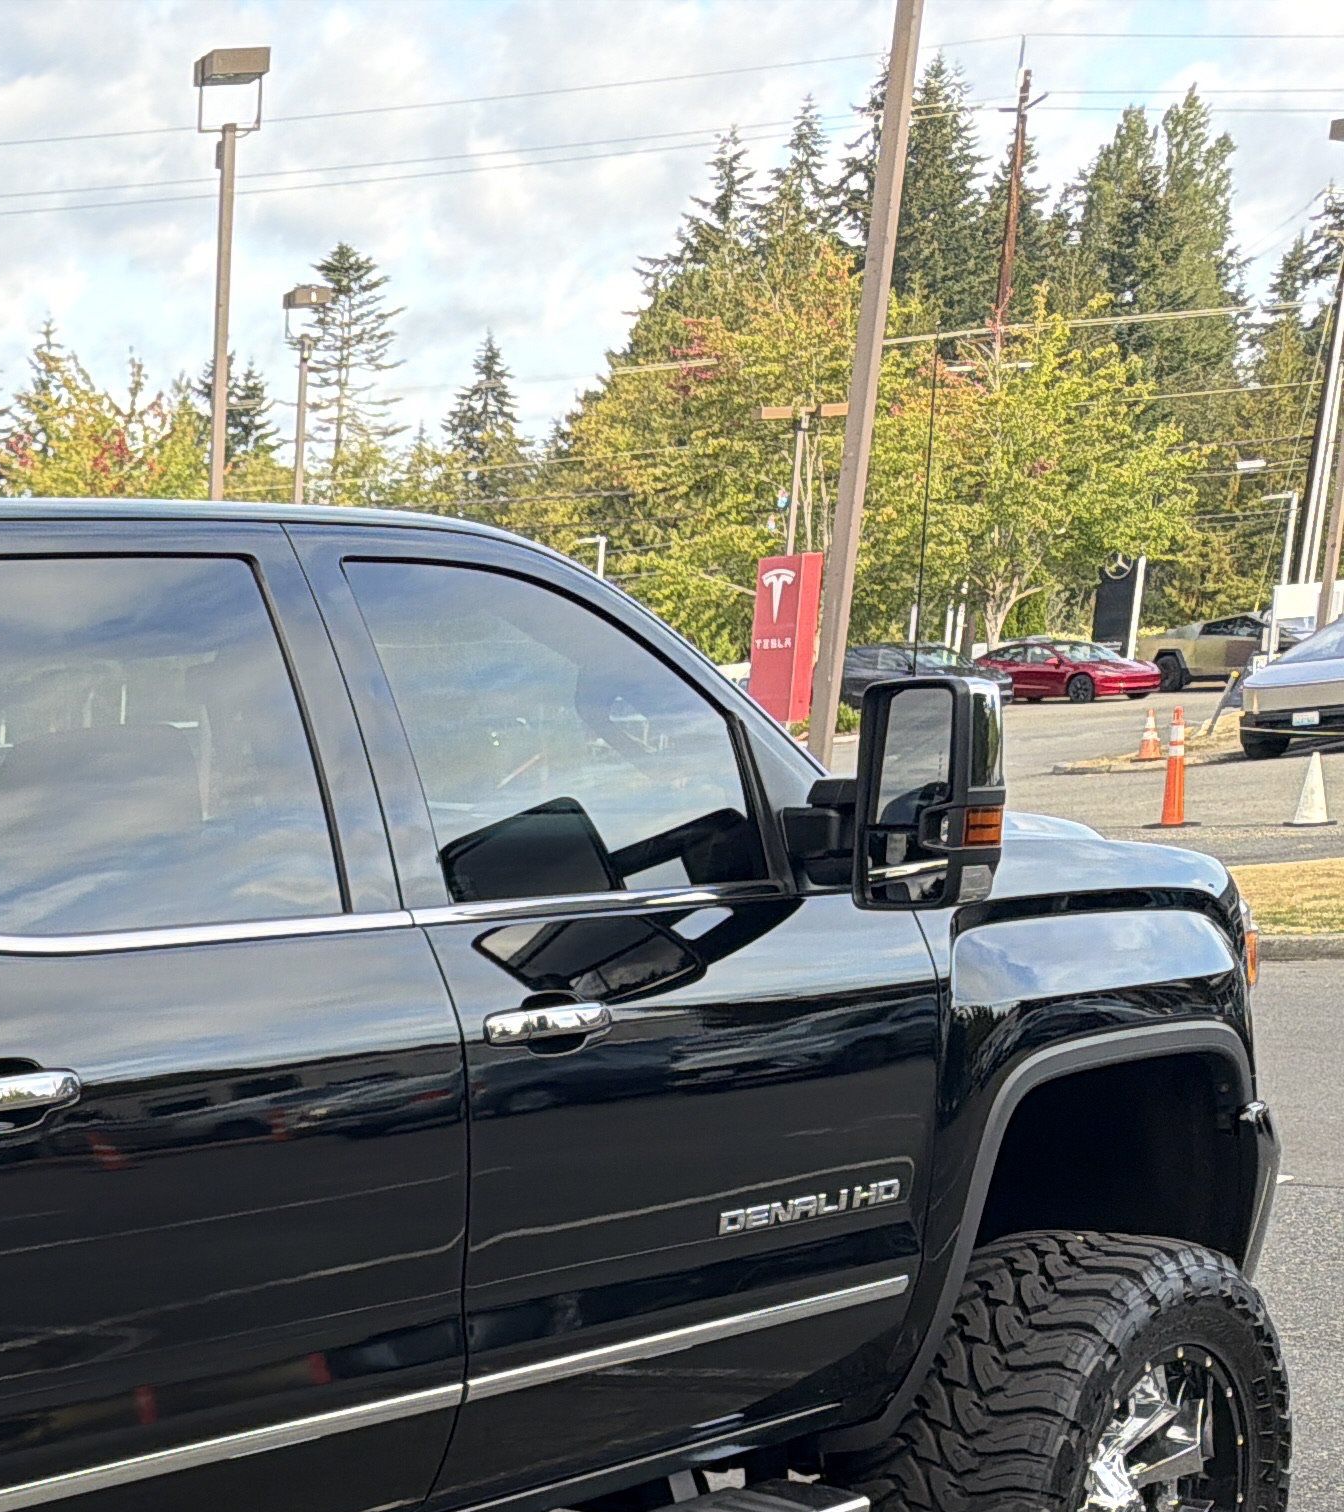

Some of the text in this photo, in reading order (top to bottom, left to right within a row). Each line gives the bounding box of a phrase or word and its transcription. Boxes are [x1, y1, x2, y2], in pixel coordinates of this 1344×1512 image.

[755, 637, 792, 650] TESLA
[718, 1178, 901, 1236] DENALI HD
